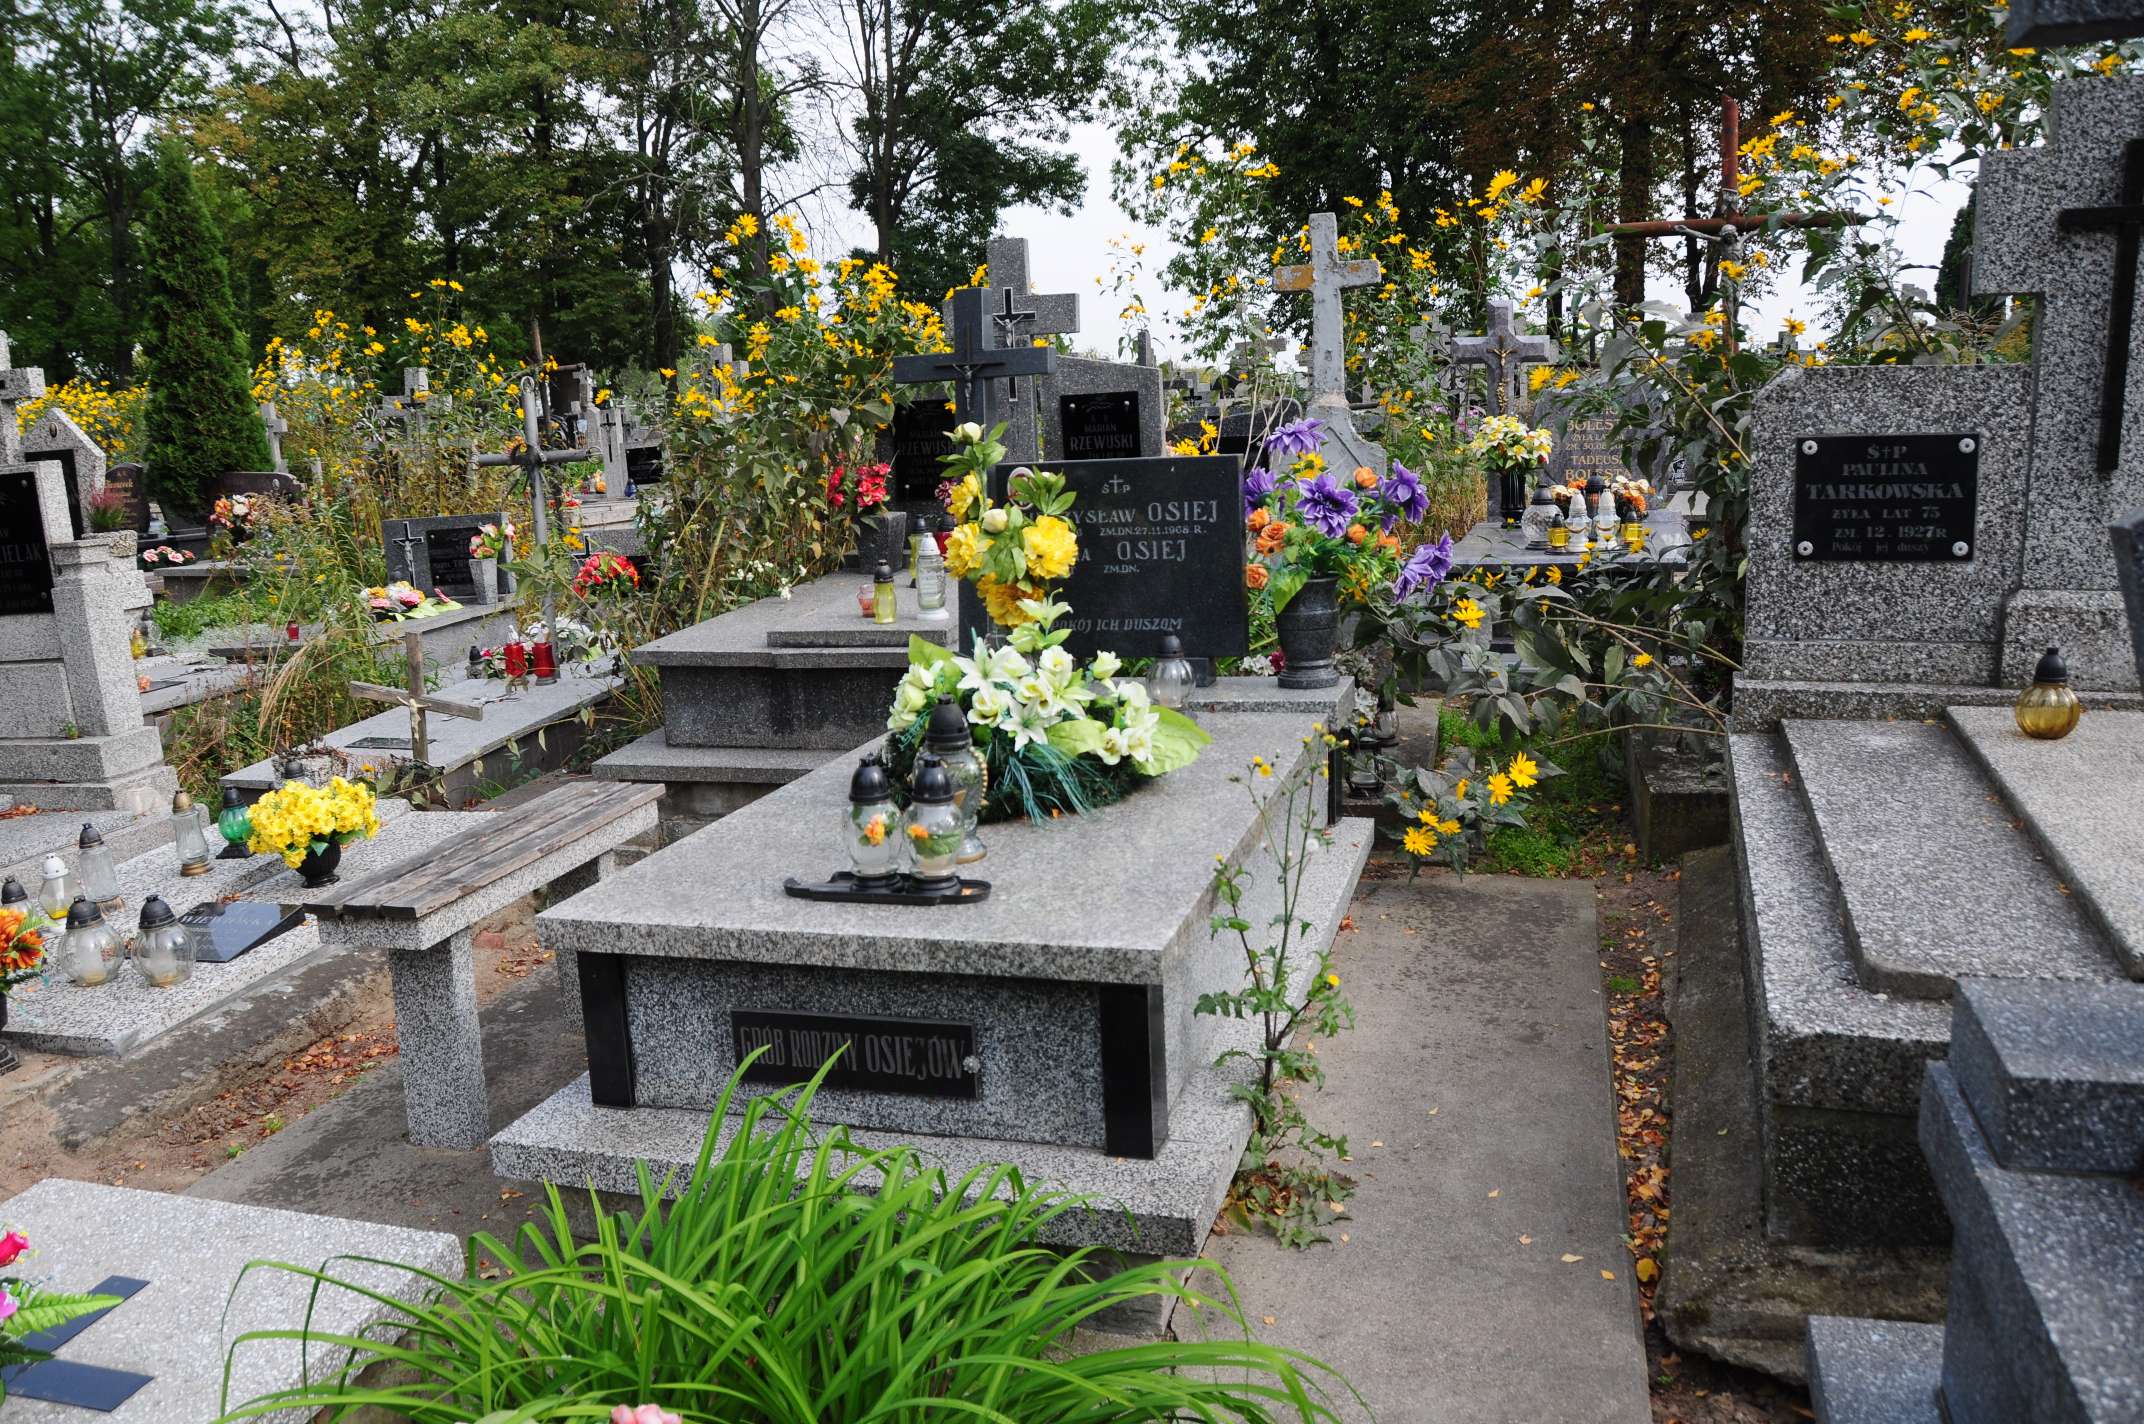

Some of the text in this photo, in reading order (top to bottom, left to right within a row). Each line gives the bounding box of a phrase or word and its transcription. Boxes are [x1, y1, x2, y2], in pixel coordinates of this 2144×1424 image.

[1069, 432, 1134, 452] RZEWUSKI
[1842, 462, 1929, 477] PAULINA
[1805, 482, 1965, 501] TARKOWSKA
[1147, 499, 1219, 524] OSIEJ
[1882, 507, 1913, 519] LAT
[1921, 505, 1942, 519] 75
[1116, 538, 1187, 563] OSIEJ
[1096, 616, 1120, 632] ICH
[864, 1034, 965, 1082] OSIEJÓW
